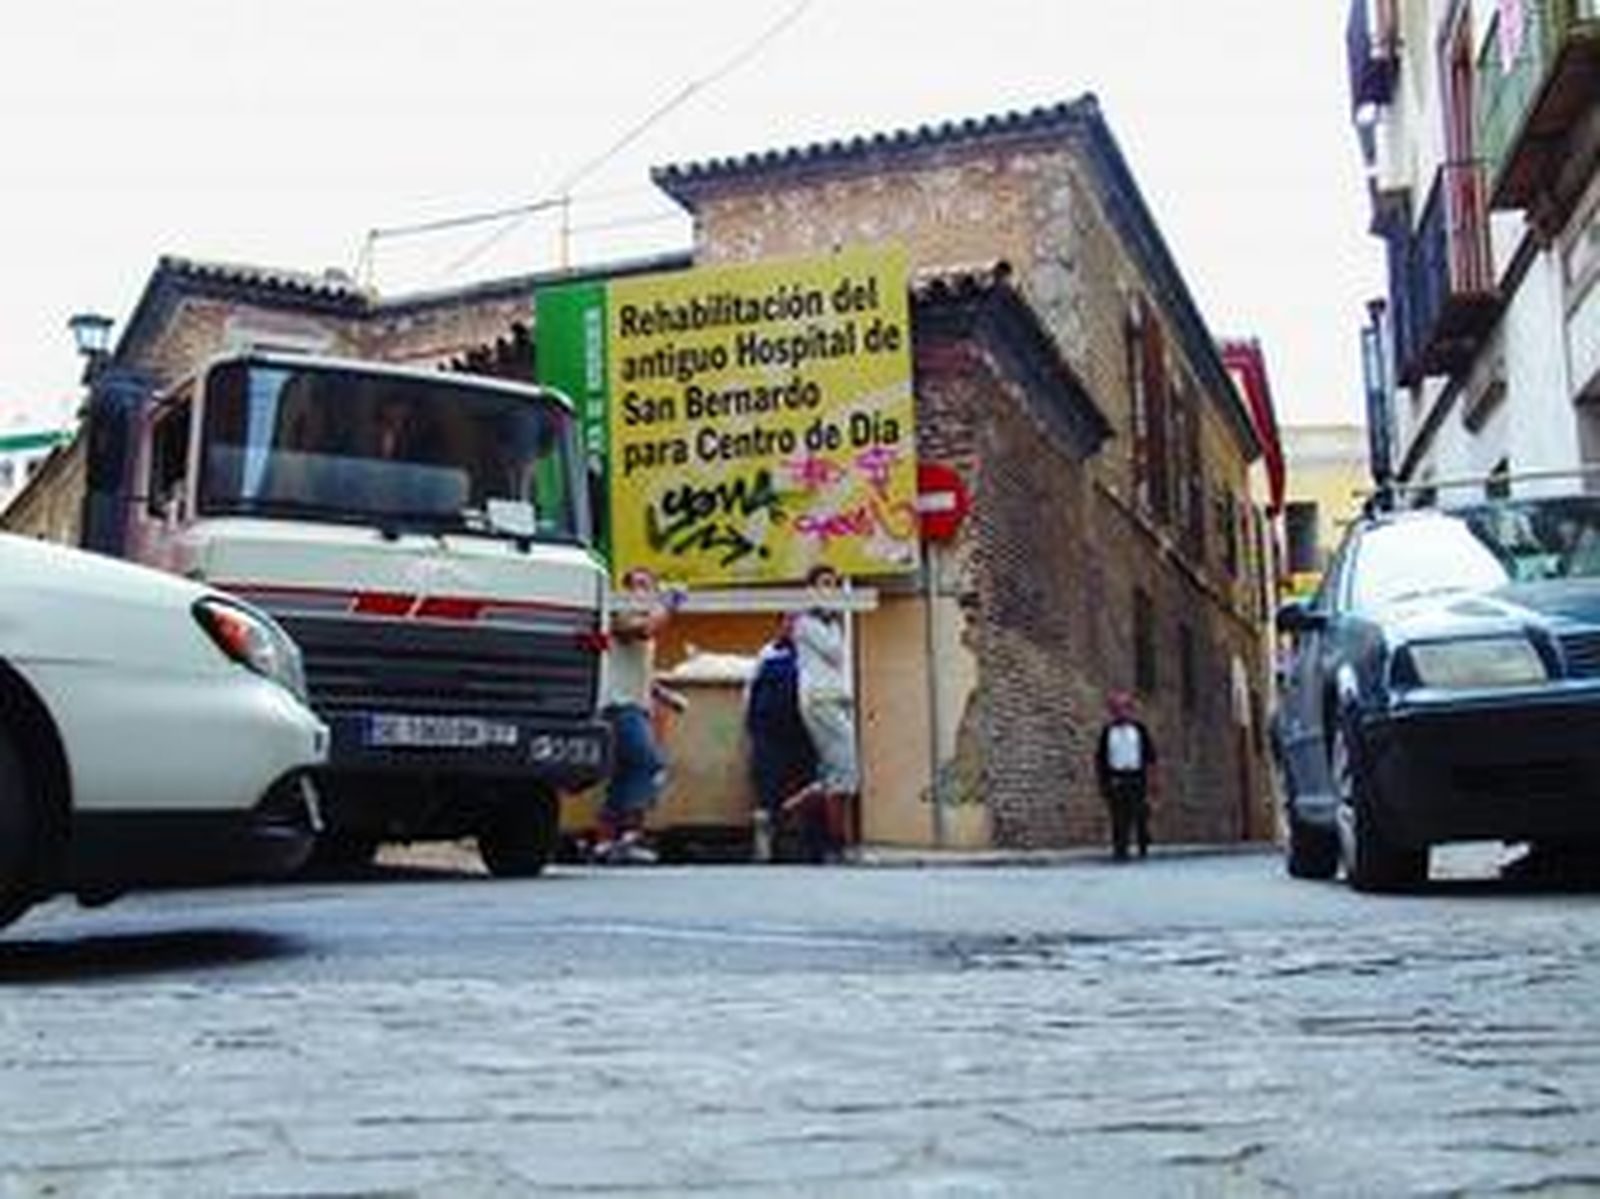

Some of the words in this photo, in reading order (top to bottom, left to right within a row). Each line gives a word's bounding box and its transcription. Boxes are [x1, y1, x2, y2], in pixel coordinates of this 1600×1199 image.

[619, 285, 823, 337] Rehabilitación
[832, 277, 879, 313] del
[621, 342, 728, 382] antiguo
[735, 321, 857, 368] Hospital
[864, 319, 900, 353] de
[623, 390, 675, 425] San
[685, 376, 820, 419] Bernardo
[624, 438, 689, 477] para
[696, 426, 795, 461] Centro
[805, 418, 840, 450] de
